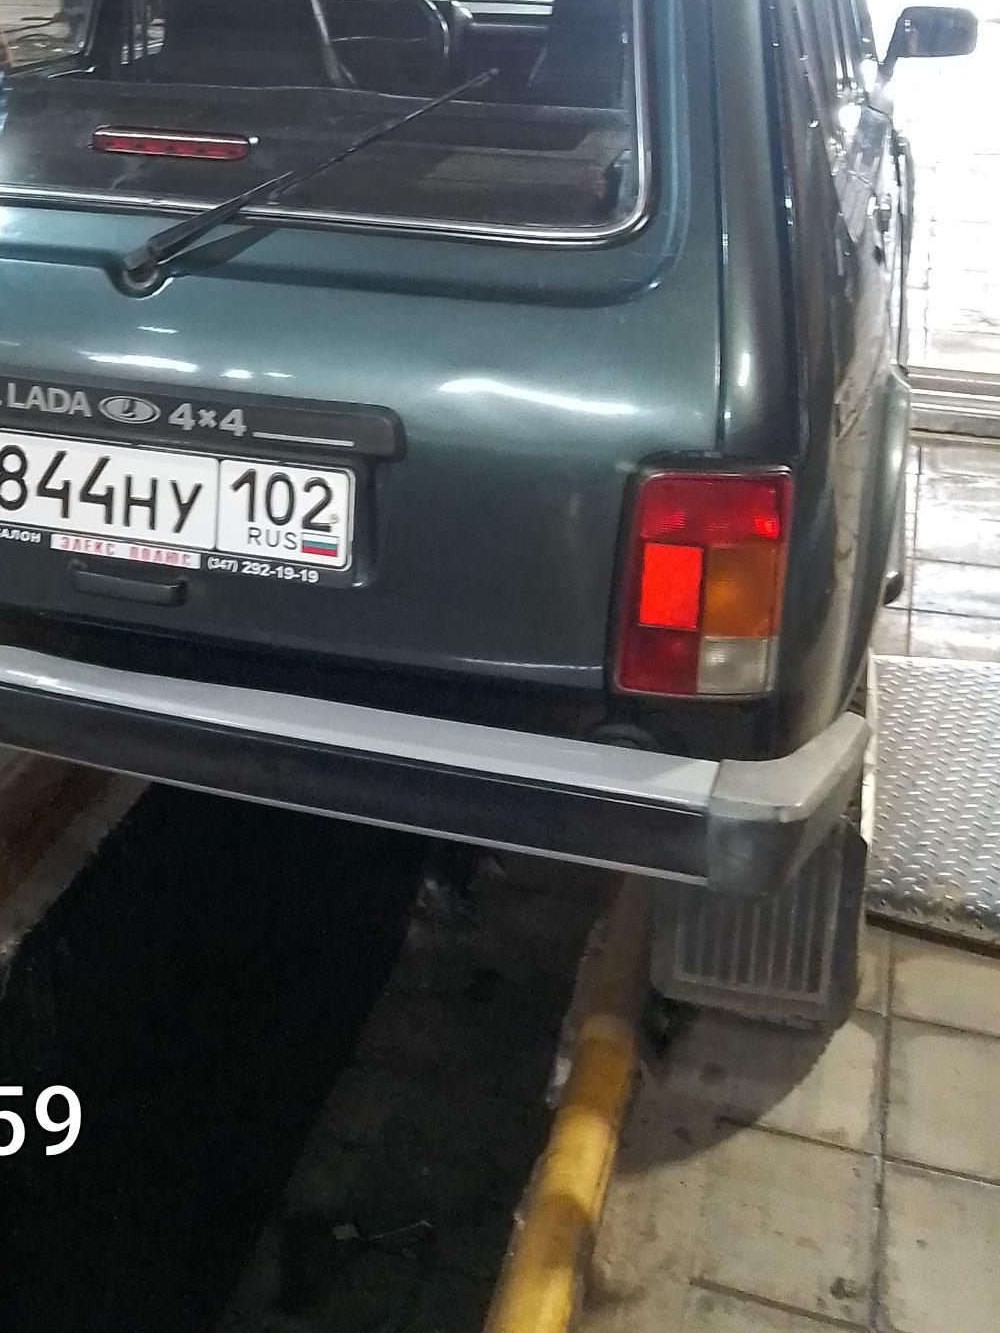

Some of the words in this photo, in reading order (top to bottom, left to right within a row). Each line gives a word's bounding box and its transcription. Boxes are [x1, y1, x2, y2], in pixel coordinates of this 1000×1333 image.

[6, 381, 93, 418] LADA
[229, 467, 334, 533] 102
[246, 526, 298, 551] RUS
[240, 559, 320, 584] 292-19-19
